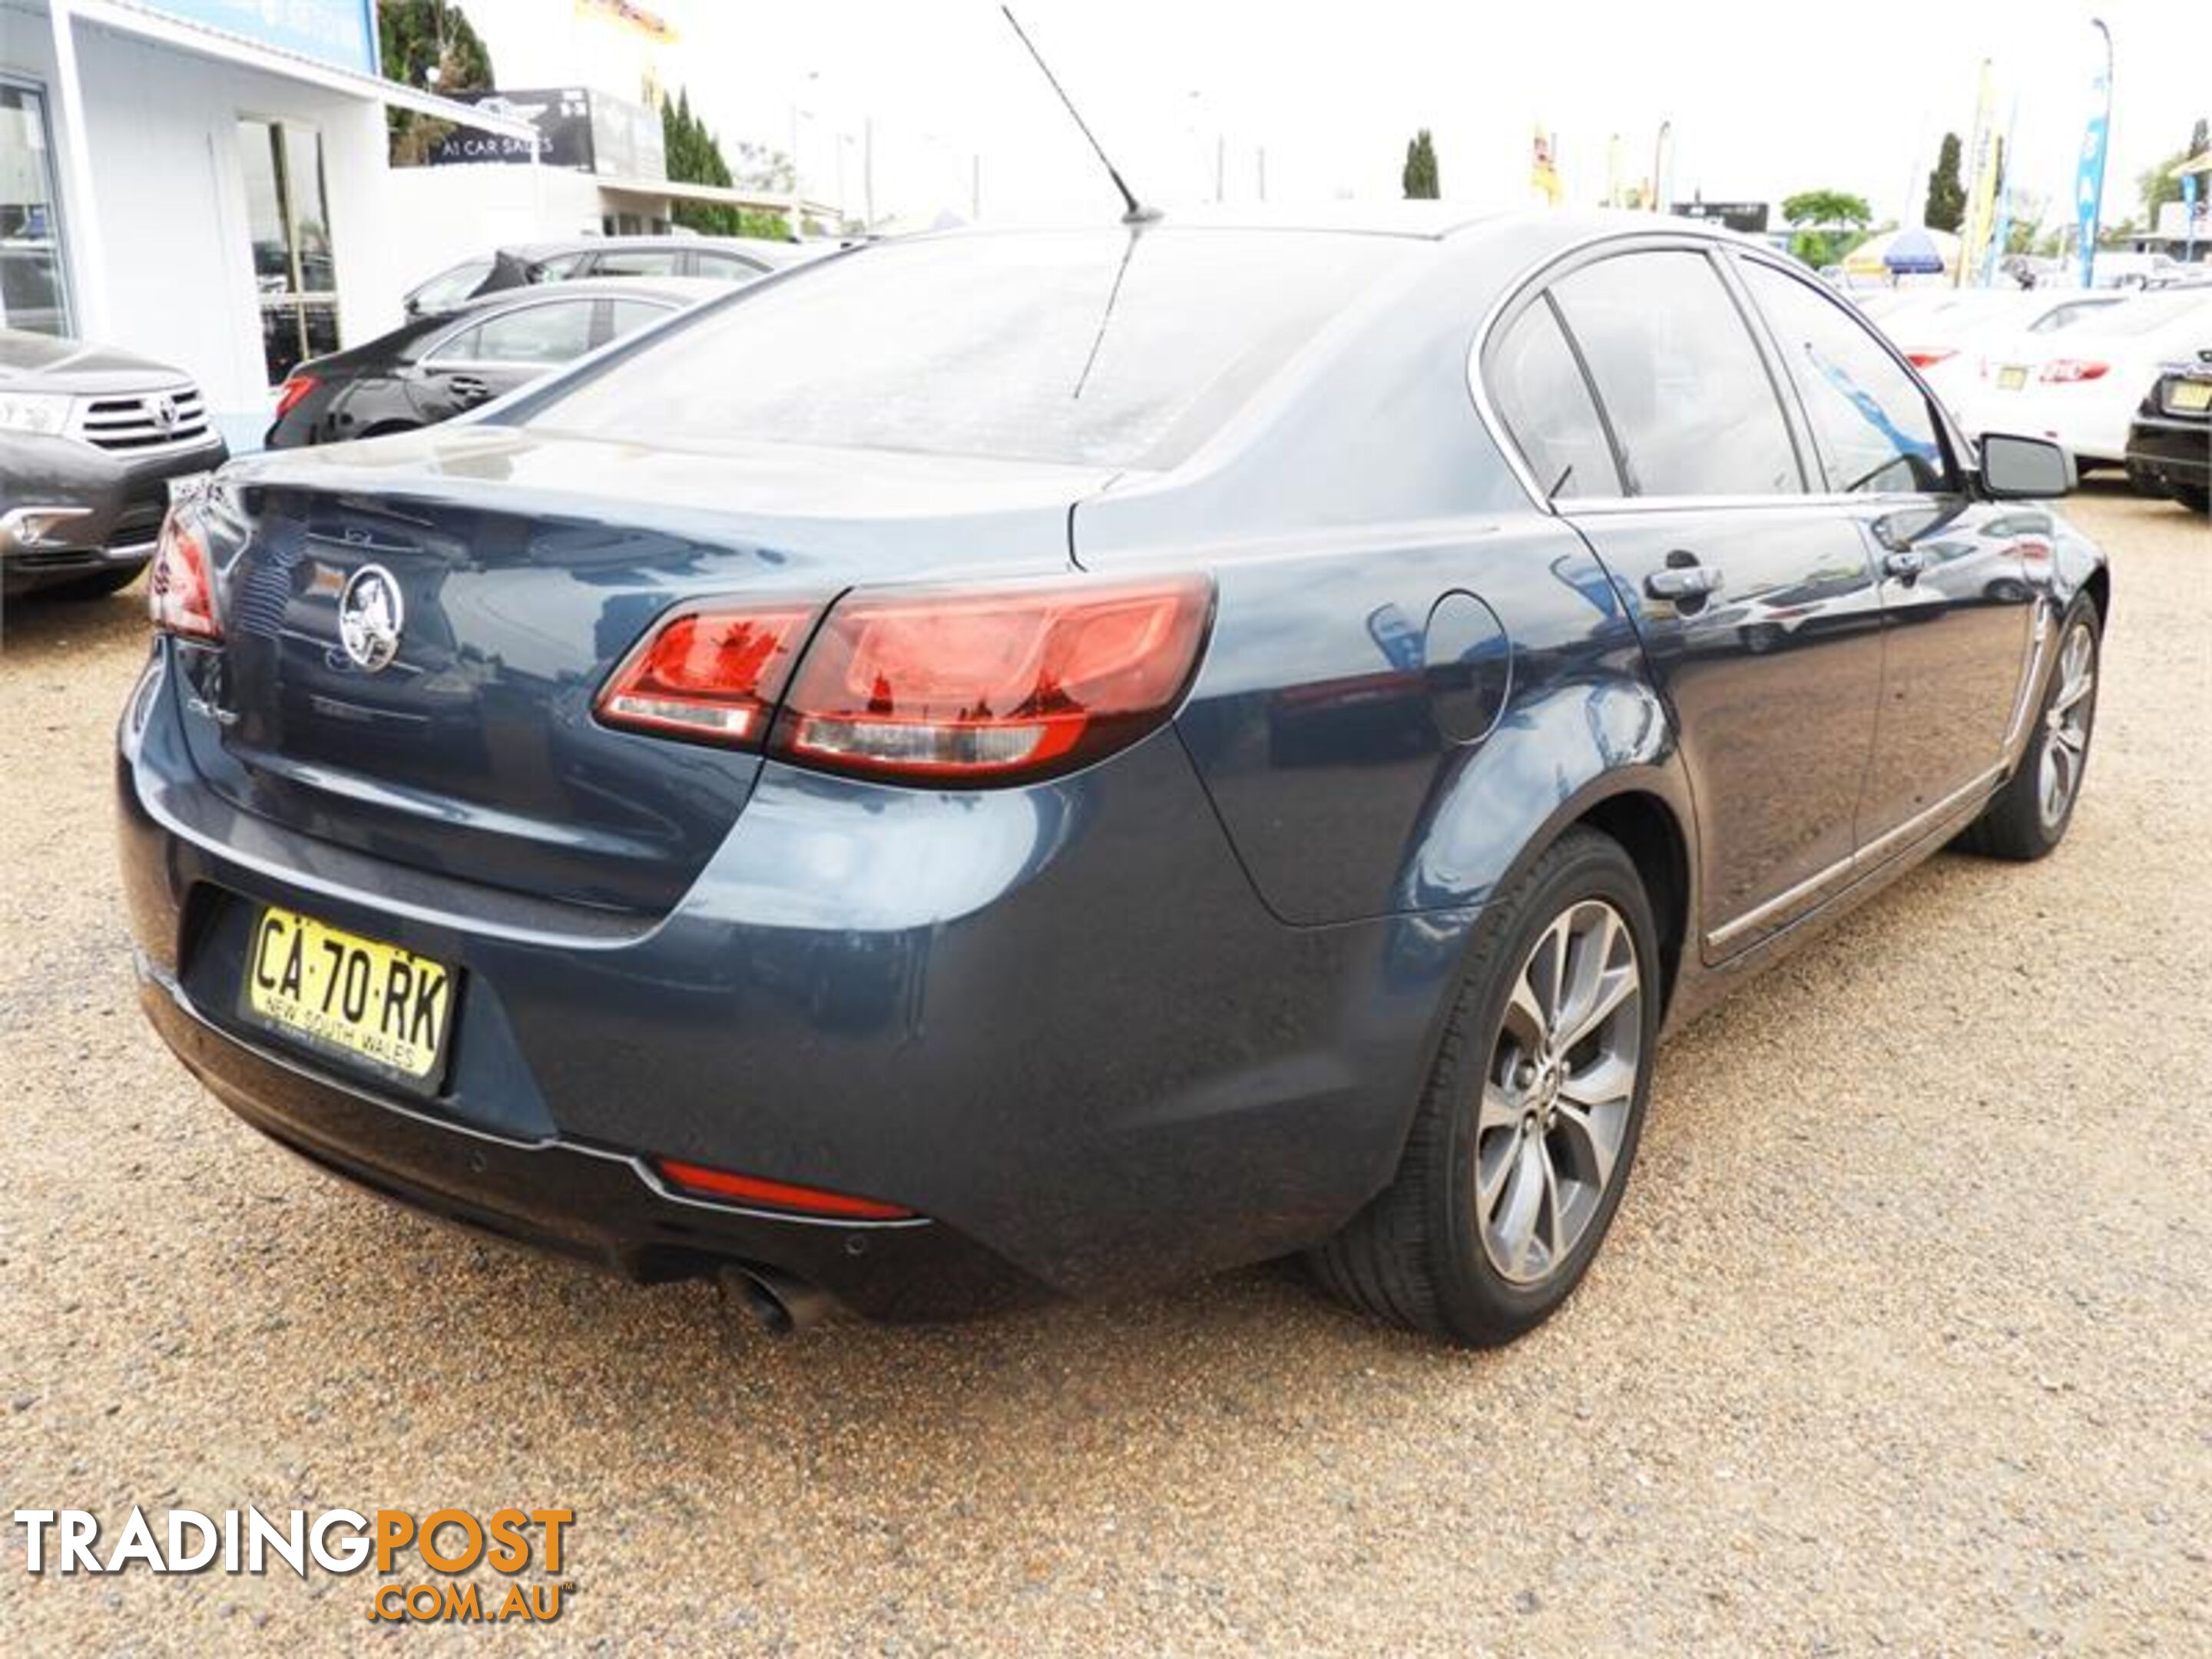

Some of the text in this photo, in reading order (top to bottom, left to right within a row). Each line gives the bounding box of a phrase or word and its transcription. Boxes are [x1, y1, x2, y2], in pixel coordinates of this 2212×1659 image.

[464, 140, 498, 156] CAR
[266, 998, 297, 1021] NEW
[306, 1010, 355, 1041] SOUTH
[362, 1035, 416, 1068] WALES
